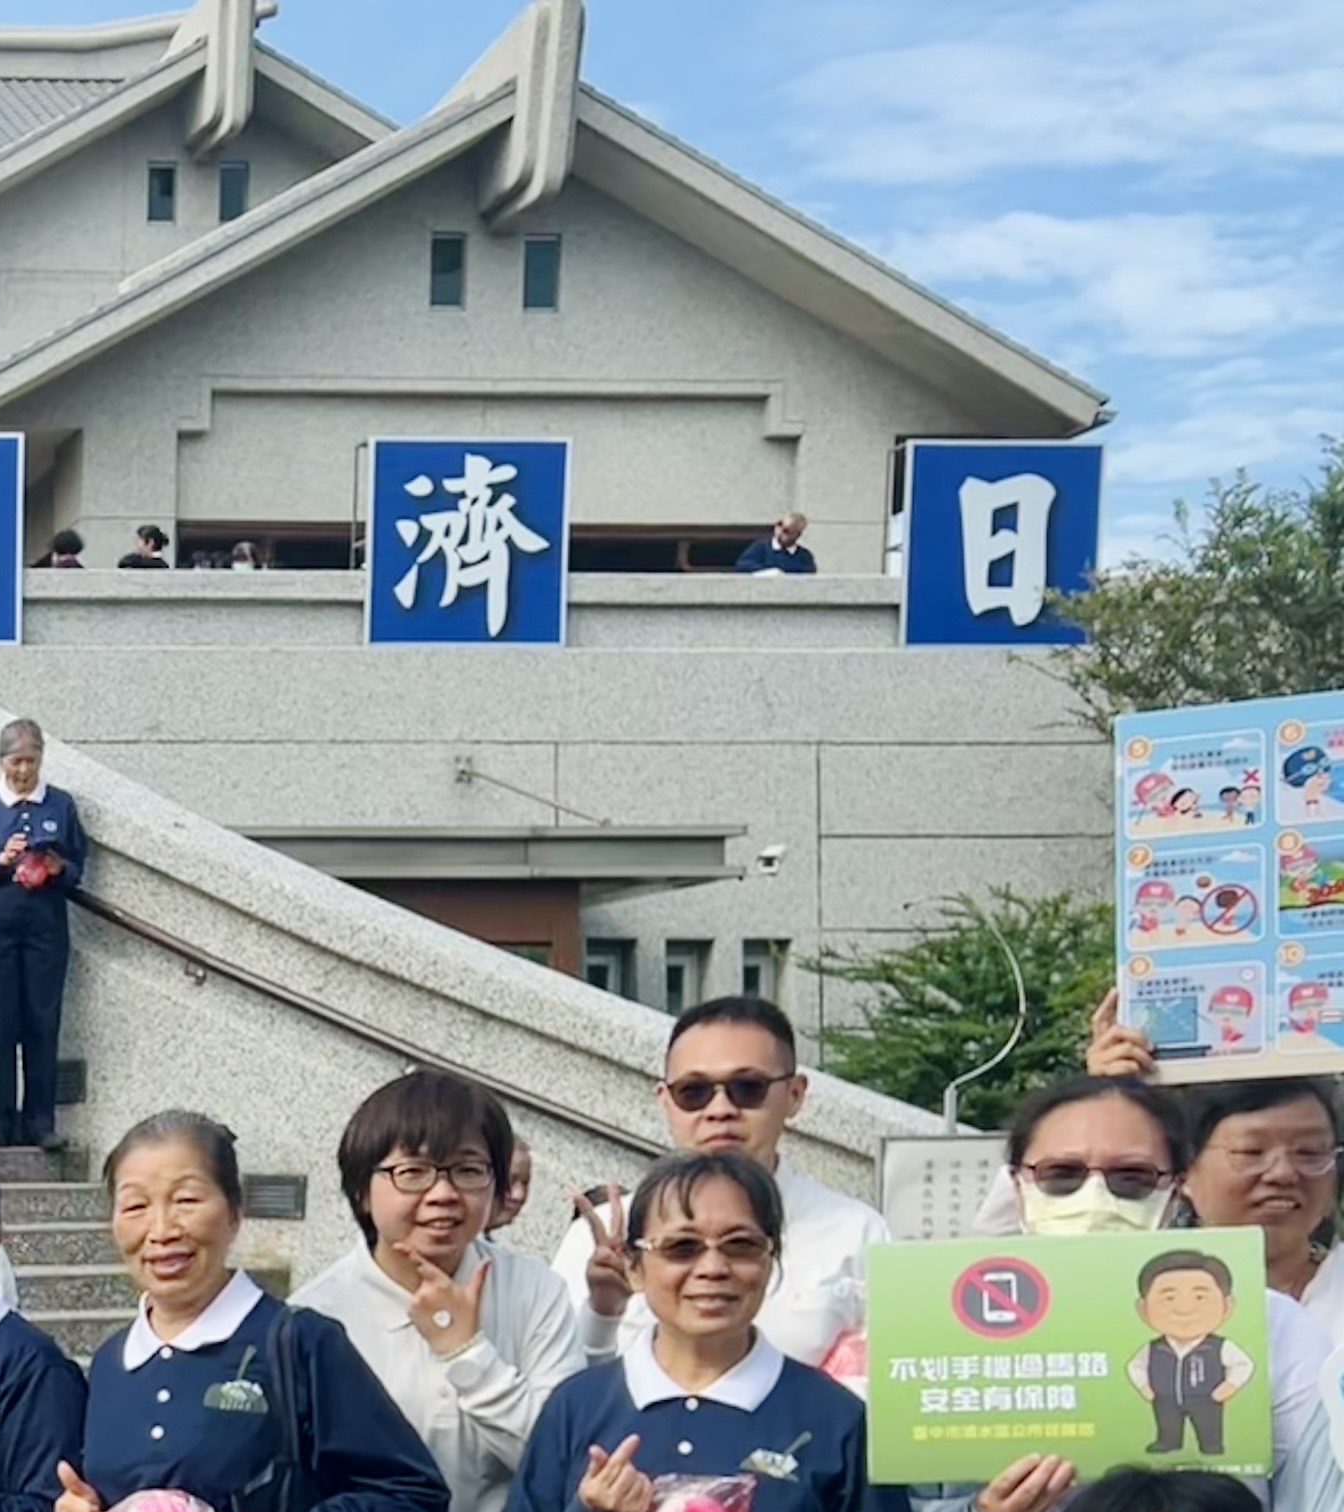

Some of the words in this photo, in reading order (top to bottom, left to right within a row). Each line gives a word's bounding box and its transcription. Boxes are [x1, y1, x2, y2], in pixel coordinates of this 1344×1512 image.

[392, 452, 551, 638] 濟
[959, 473, 1057, 628] 日
[888, 1351, 1109, 1382] 不划手機過馬路
[919, 1384, 1077, 1413] 安全有保障
